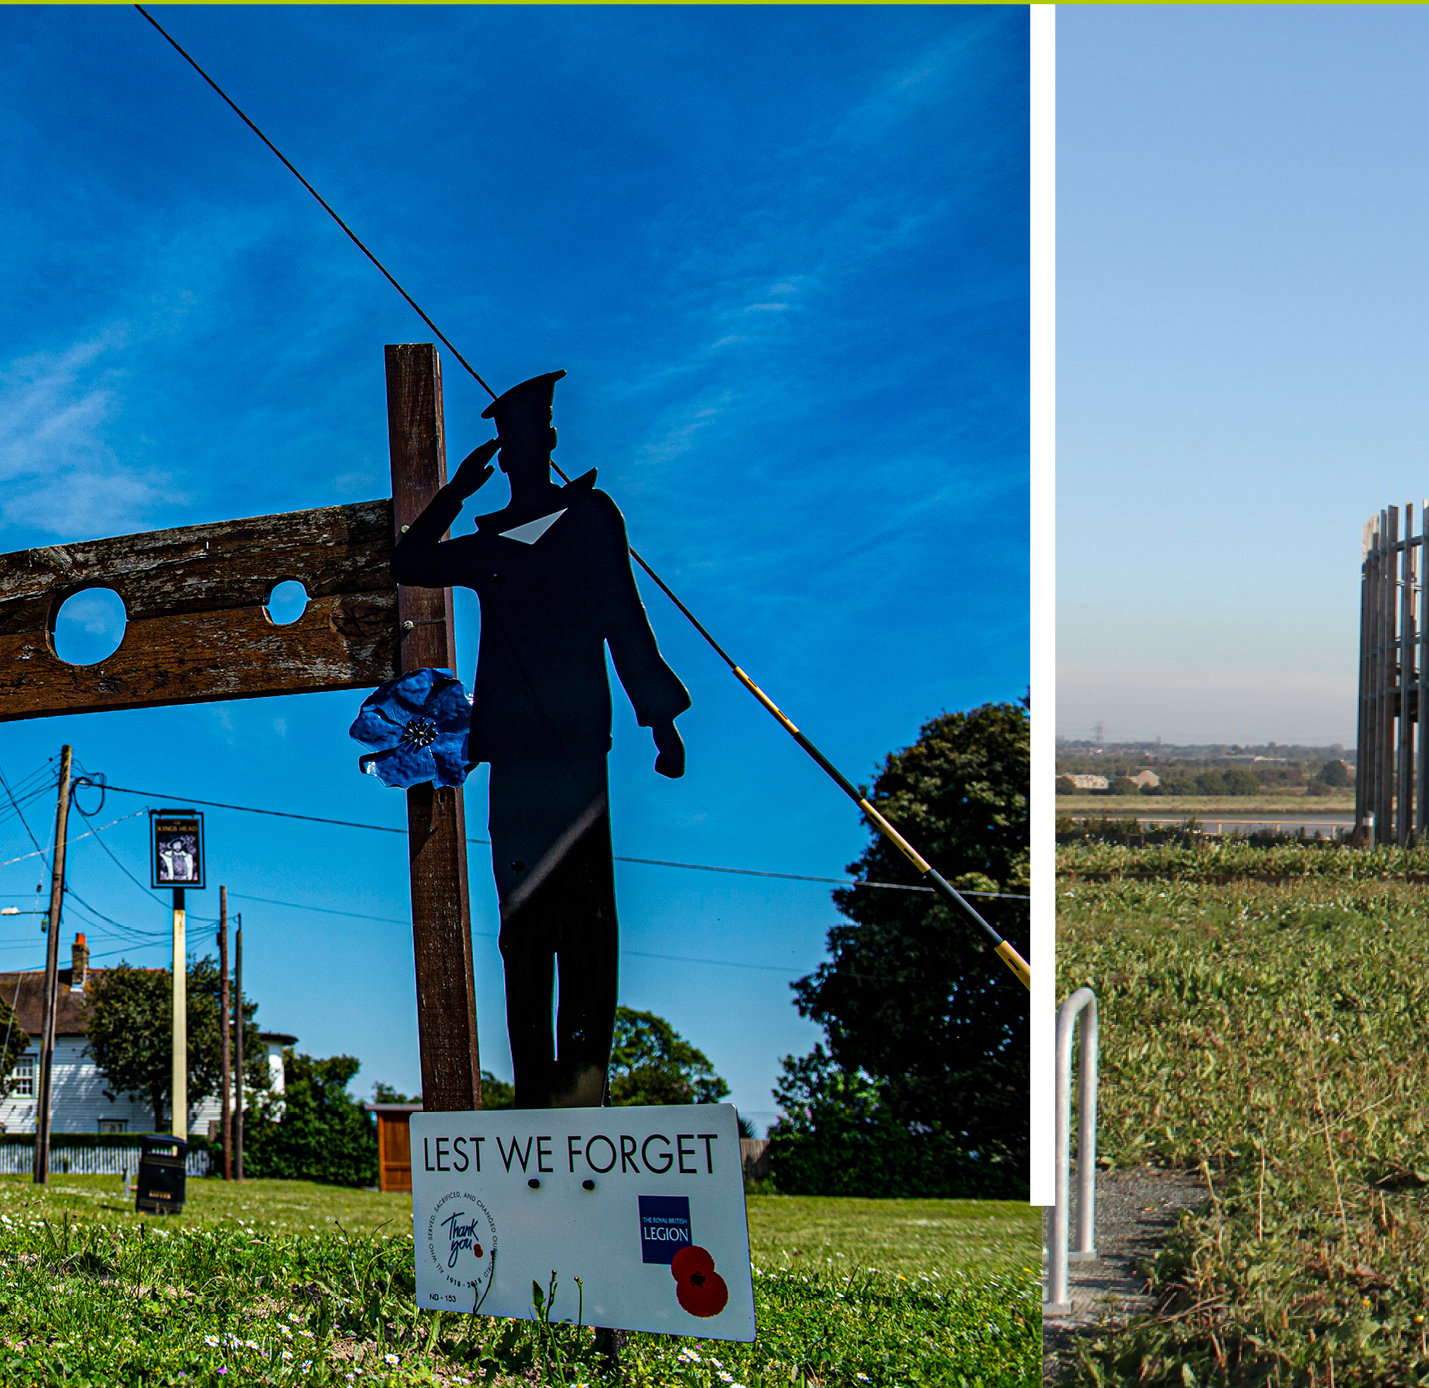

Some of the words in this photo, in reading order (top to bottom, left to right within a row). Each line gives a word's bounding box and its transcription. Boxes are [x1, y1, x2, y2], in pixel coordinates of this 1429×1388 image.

[423, 1136, 486, 1172] LEST
[496, 1135, 554, 1173] WE
[567, 1133, 719, 1175] FORGET
[463, 1192, 476, 1202] AND
[476, 1199, 497, 1233] CHANGED
[669, 1217, 688, 1225] BRITISH
[440, 1212, 479, 1241] Thank
[644, 1226, 689, 1242] LEGION
[429, 1243, 437, 1263] WHO
[447, 1238, 472, 1268] you
[435, 1263, 444, 1274] ALL
[446, 1275, 461, 1287] 1918
